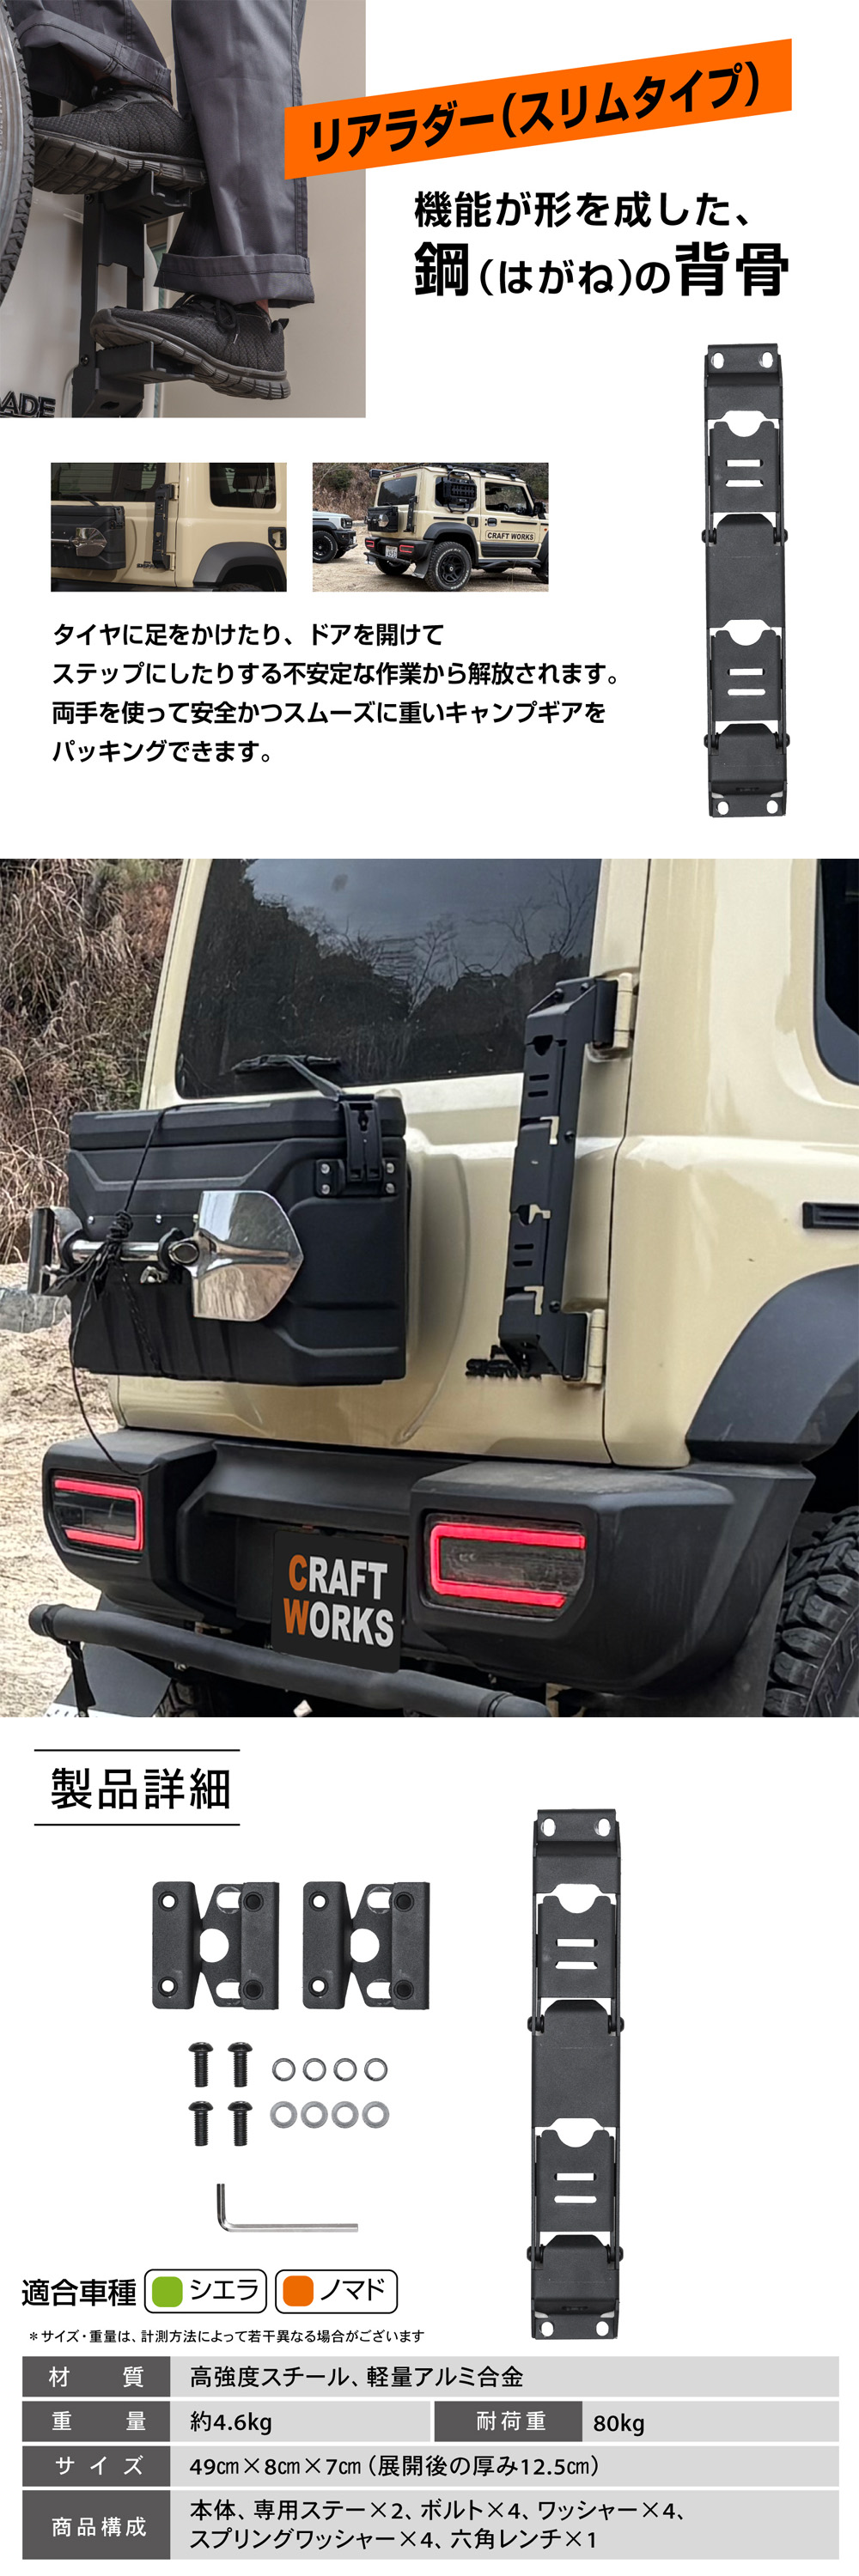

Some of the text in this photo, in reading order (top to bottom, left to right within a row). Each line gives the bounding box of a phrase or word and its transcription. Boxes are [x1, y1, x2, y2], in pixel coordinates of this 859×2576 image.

[0, 391, 56, 417] ADE
[289, 1554, 387, 1600] CRAFT
[283, 1598, 394, 1648] WORKS
